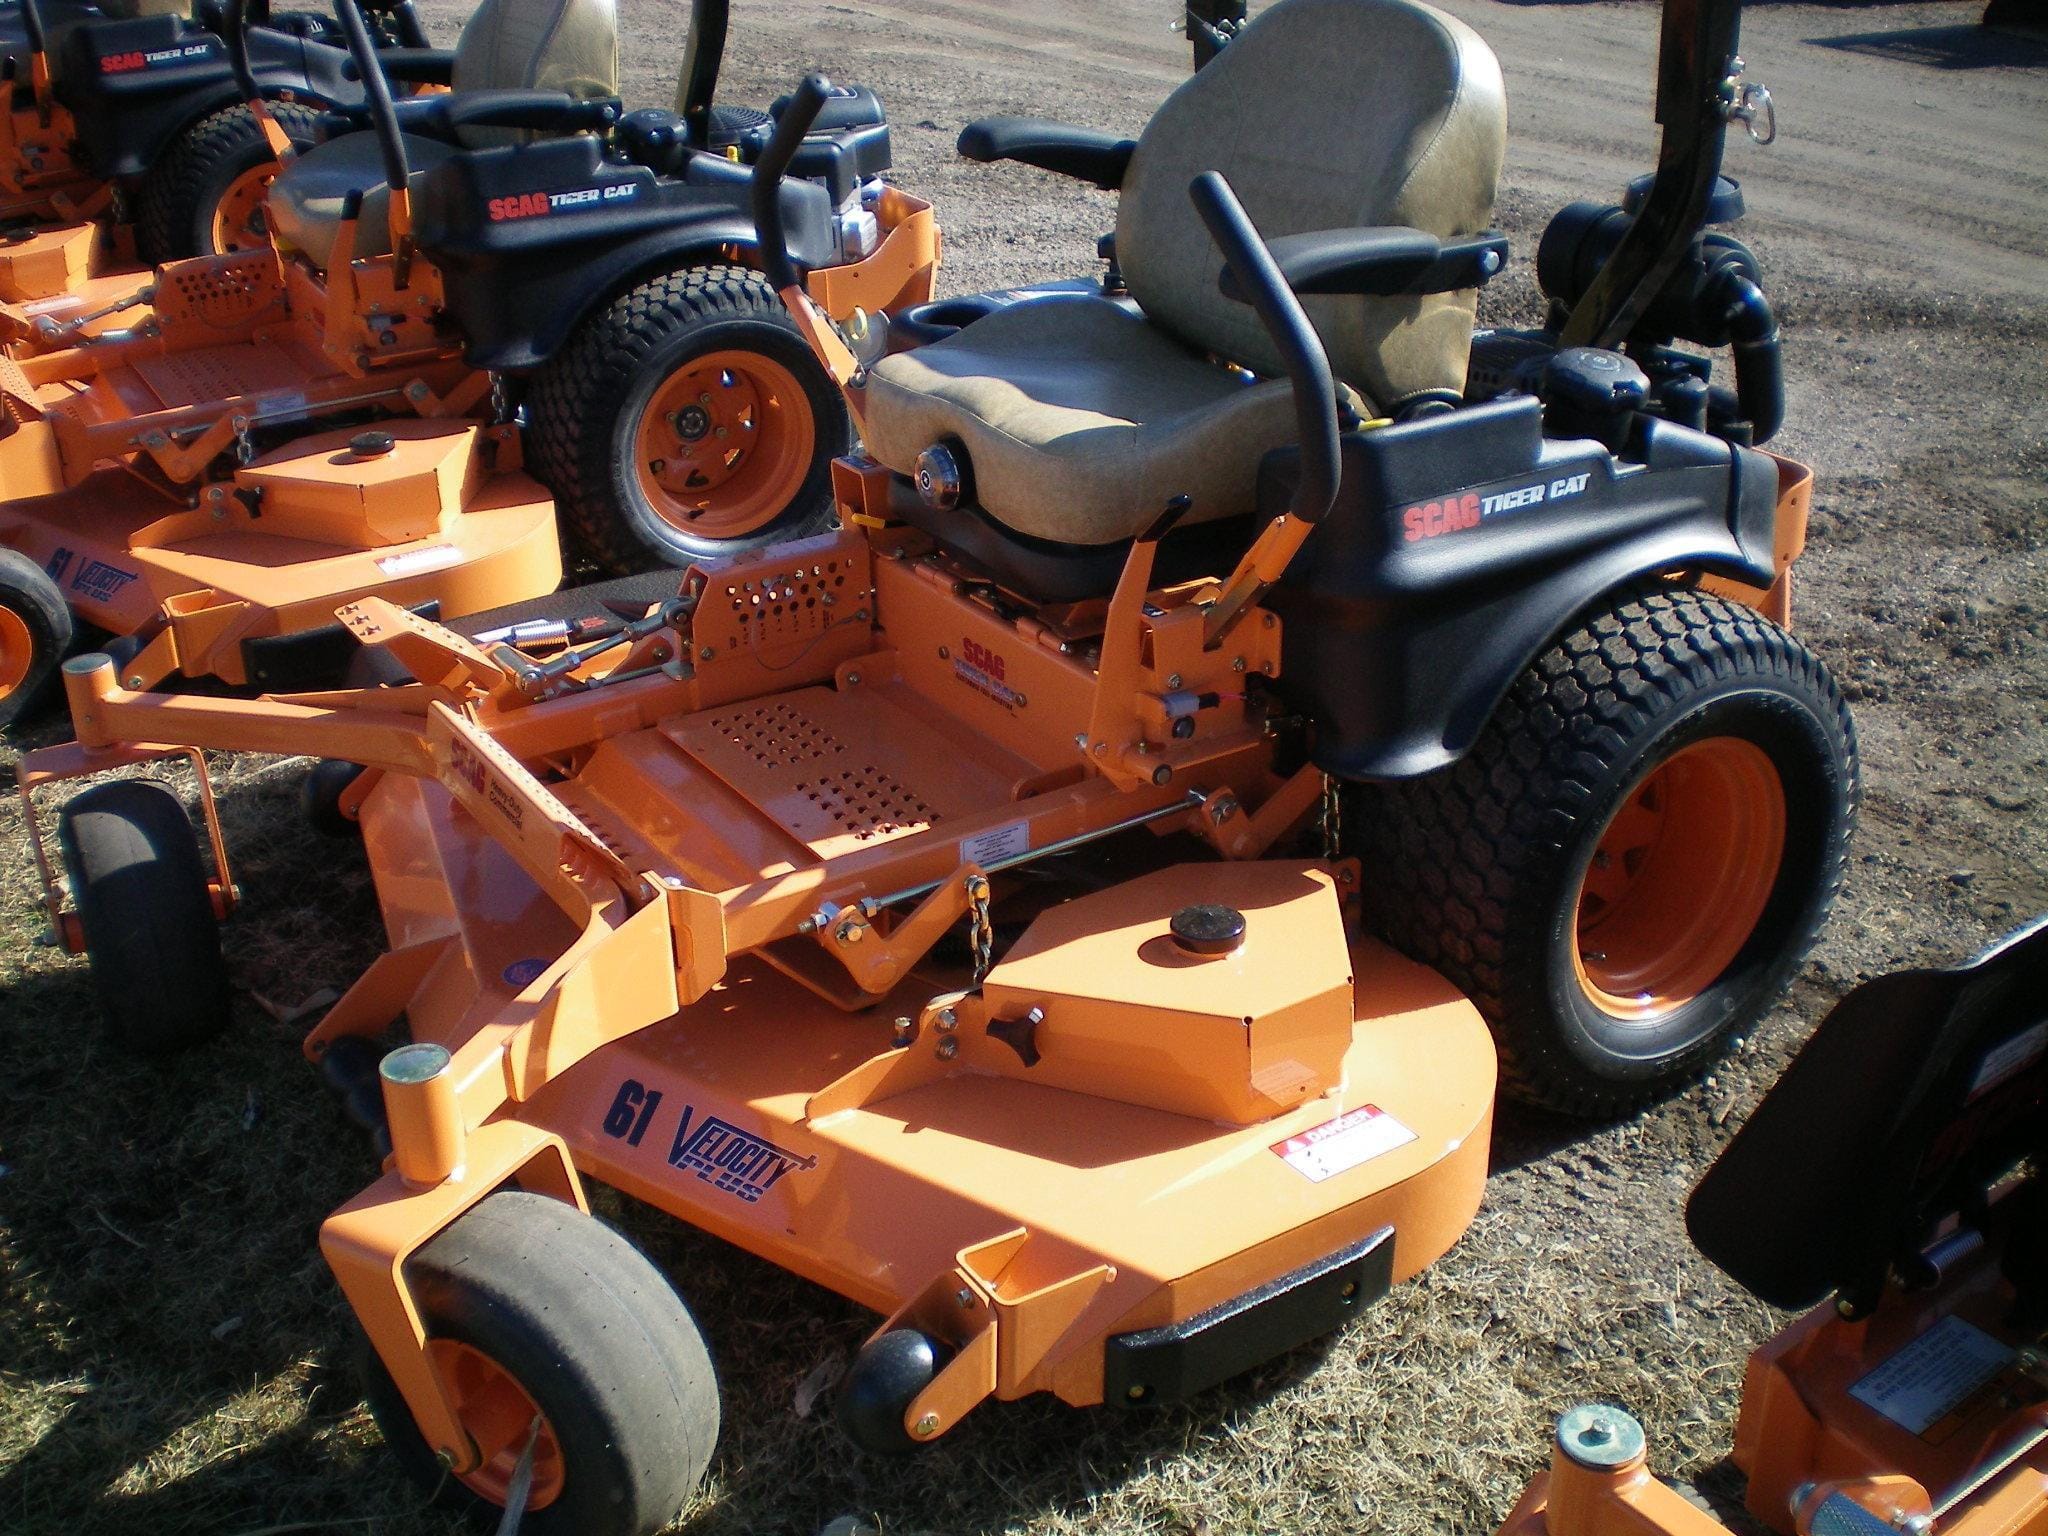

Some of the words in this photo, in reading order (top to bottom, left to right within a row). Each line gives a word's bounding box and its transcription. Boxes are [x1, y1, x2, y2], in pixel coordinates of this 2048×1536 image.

[184, 44, 208, 56] CAT
[488, 192, 549, 220] SCAG
[549, 189, 600, 207] TIGER
[603, 183, 638, 199] CAT
[1402, 494, 1481, 543] SCAG
[1481, 483, 1545, 517] TIGER
[1550, 472, 1592, 501] CAT
[963, 637, 1005, 681] SCAG
[451, 736, 487, 795] SCAG
[602, 1079, 663, 1148] 61
[1304, 1111, 1372, 1144] DANGER
[677, 1154, 764, 1204] PLUS
